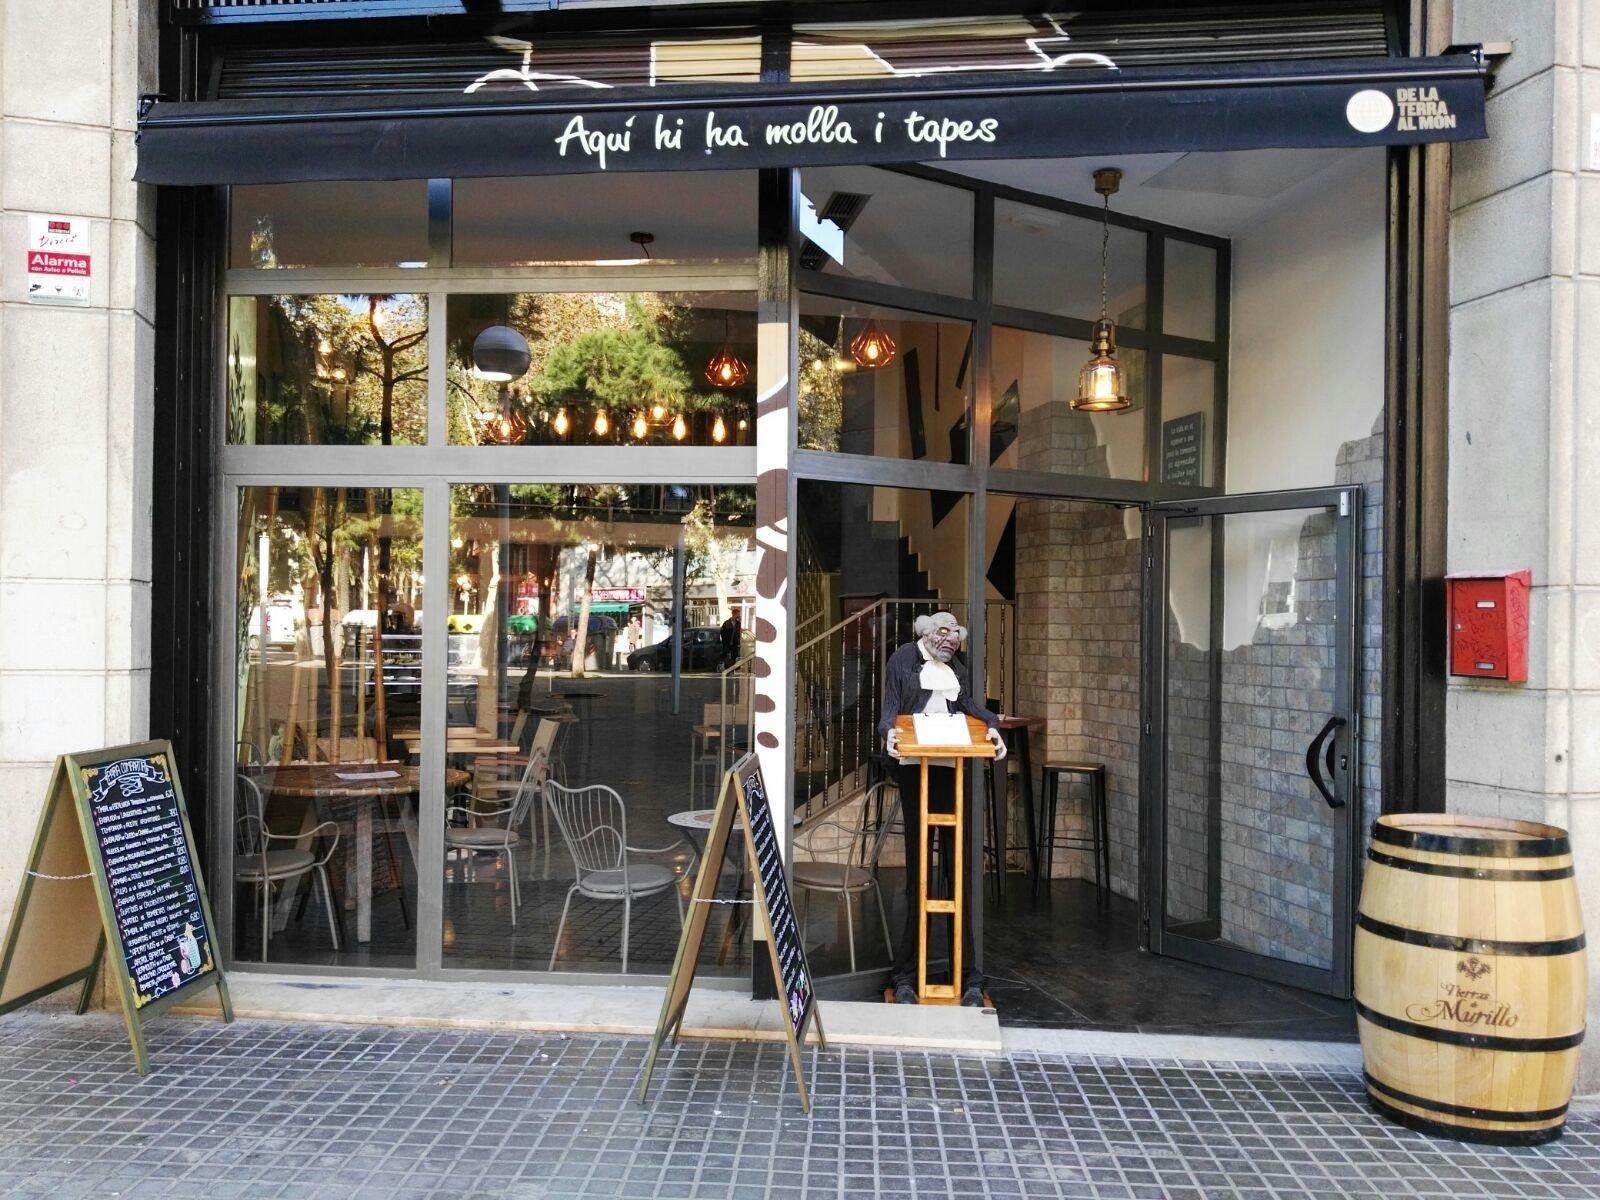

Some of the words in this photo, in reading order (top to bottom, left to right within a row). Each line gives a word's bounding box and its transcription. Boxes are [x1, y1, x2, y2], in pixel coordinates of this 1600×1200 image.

[1397, 88, 1417, 102] DE
[1419, 87, 1439, 101] LA
[1398, 101, 1448, 116] TERRA
[1397, 116, 1417, 131] AL
[555, 114, 636, 169] Aquí
[654, 113, 683, 150] hi
[705, 111, 748, 148] ha
[766, 105, 857, 145] molla
[875, 112, 885, 143] i
[904, 111, 999, 158] tapes
[31, 254, 87, 268] Alarma
[1440, 982, 1490, 1000] Tierras
[1406, 999, 1519, 1028] Murillo
